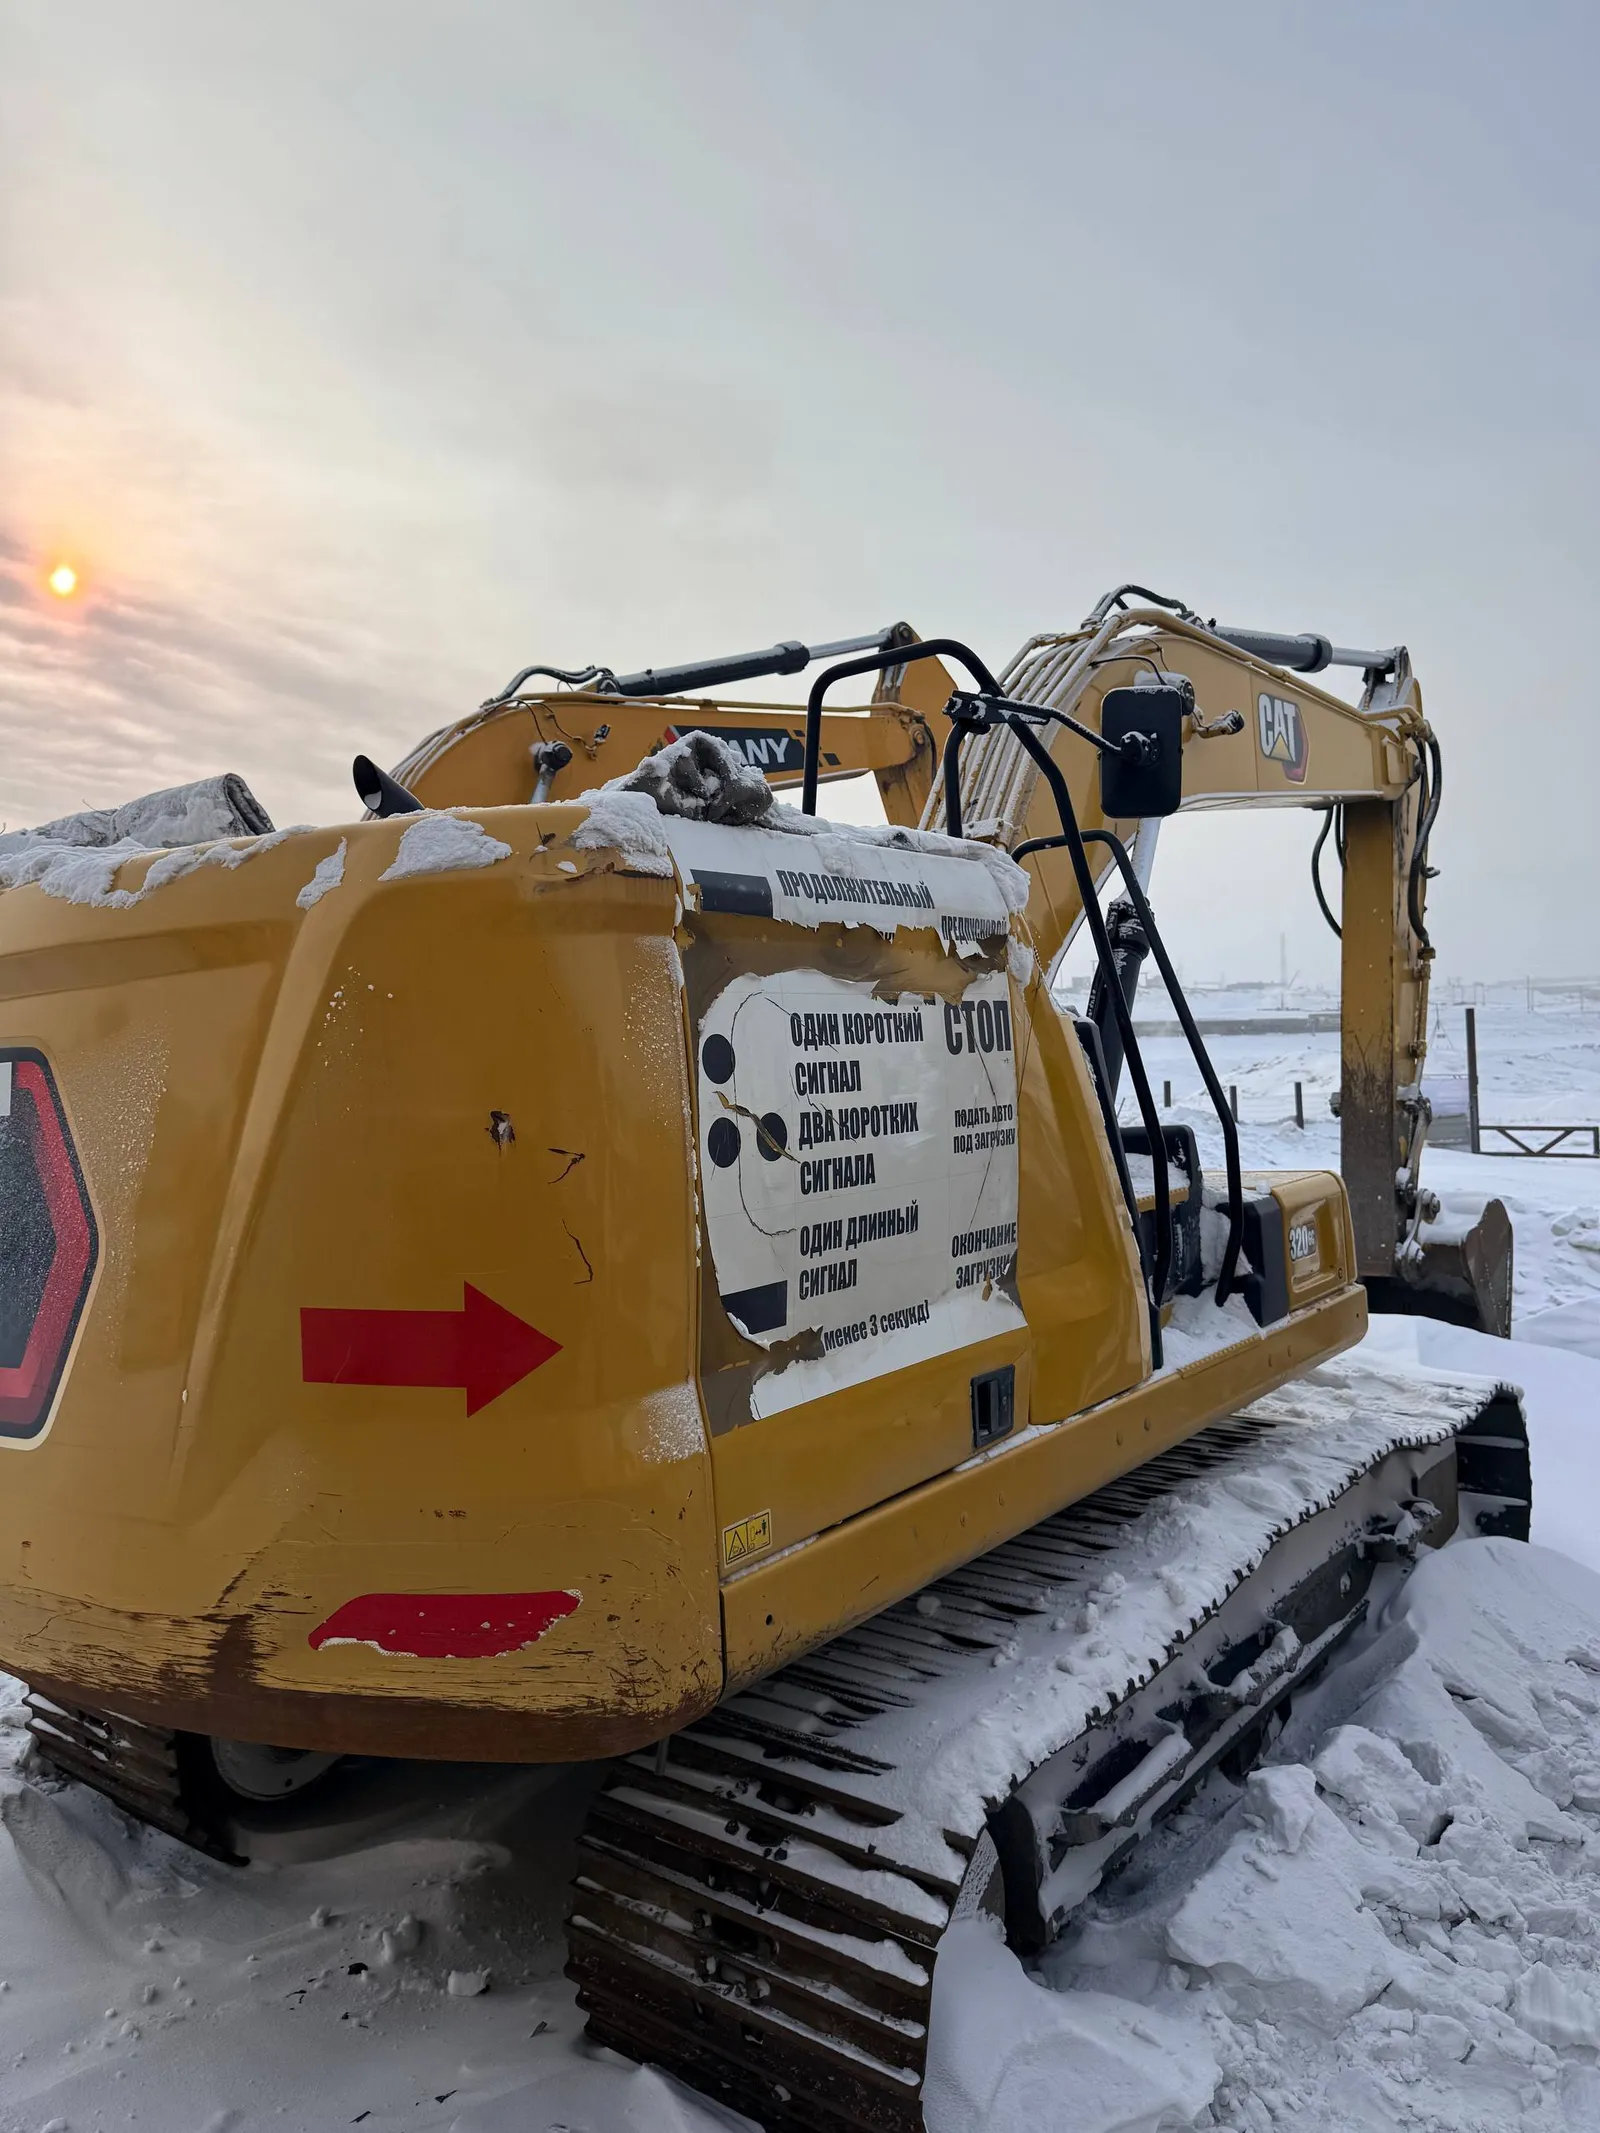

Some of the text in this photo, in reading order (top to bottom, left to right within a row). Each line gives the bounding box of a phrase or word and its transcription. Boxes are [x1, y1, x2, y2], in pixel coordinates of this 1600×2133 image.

[1259, 693, 1296, 762] CAT
[727, 736, 789, 765] ANY
[776, 869, 936, 910] ПРОДОЛЖИТЕЛЬНЫЙ
[790, 1006, 924, 1052] ОДИН КОРОТКИЙ
[944, 1000, 1012, 1056] СТОП
[795, 1060, 862, 1096] СИГНАЛ
[799, 1102, 919, 1151] ДВА КОРОТКИХ
[954, 1103, 1013, 1129] ПОДАТЬ АВТО
[953, 1127, 1015, 1155] ПОД ЗАГРУЗКУ
[800, 1153, 877, 1195] СИГНАЛА
[800, 1199, 919, 1258] ОДИН ДЛИННЫЙ
[951, 1221, 1017, 1258] ОКОНЧАНИЕ
[800, 1258, 858, 1300] СИГНАЛ
[956, 1253, 1011, 1290] ЗАГРУЗКИ
[824, 1320, 868, 1351] менее
[869, 1313, 879, 1337] 3
